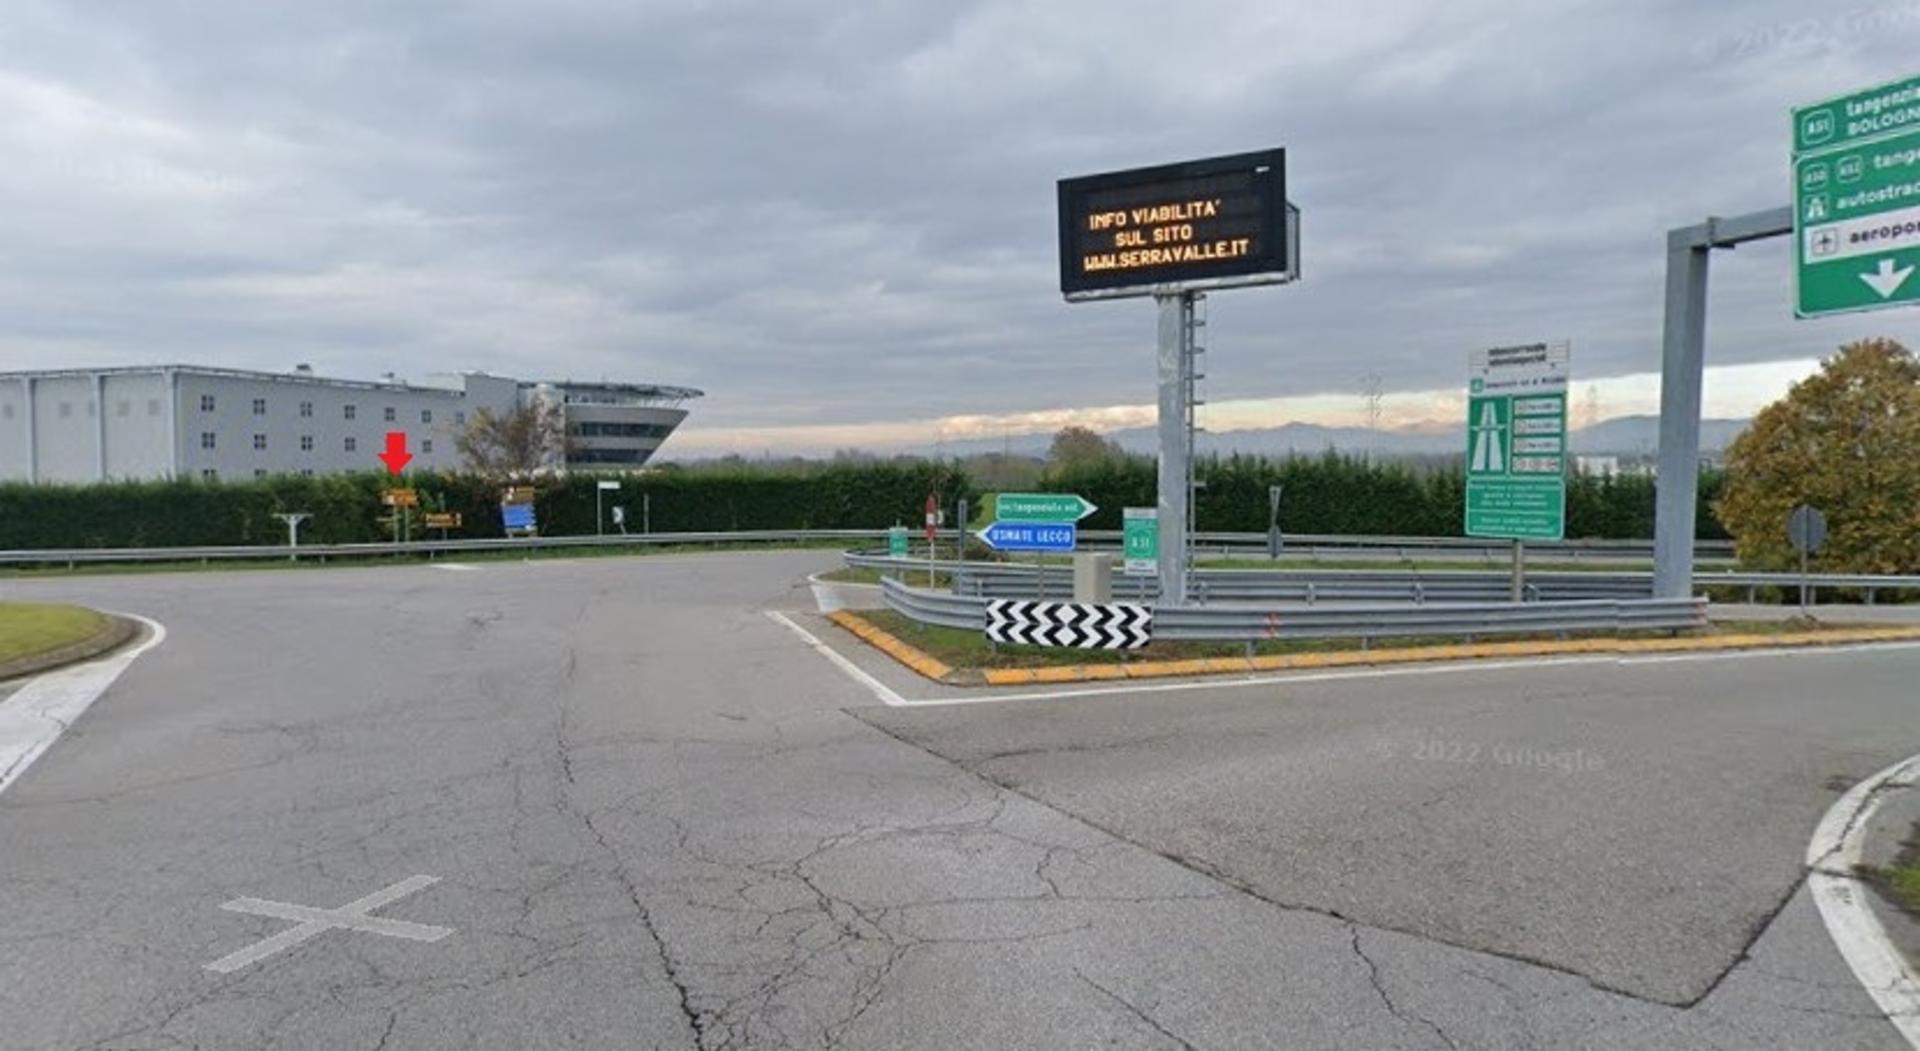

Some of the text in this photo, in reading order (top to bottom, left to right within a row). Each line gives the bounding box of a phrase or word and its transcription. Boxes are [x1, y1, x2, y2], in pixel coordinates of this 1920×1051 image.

[1089, 212, 1127, 230] INFO
[1115, 224, 1193, 247] SUL SITO
[1084, 238, 1249, 271] WWW.SERRAVALLE.IT
[1036, 529, 1071, 543] LECCO
